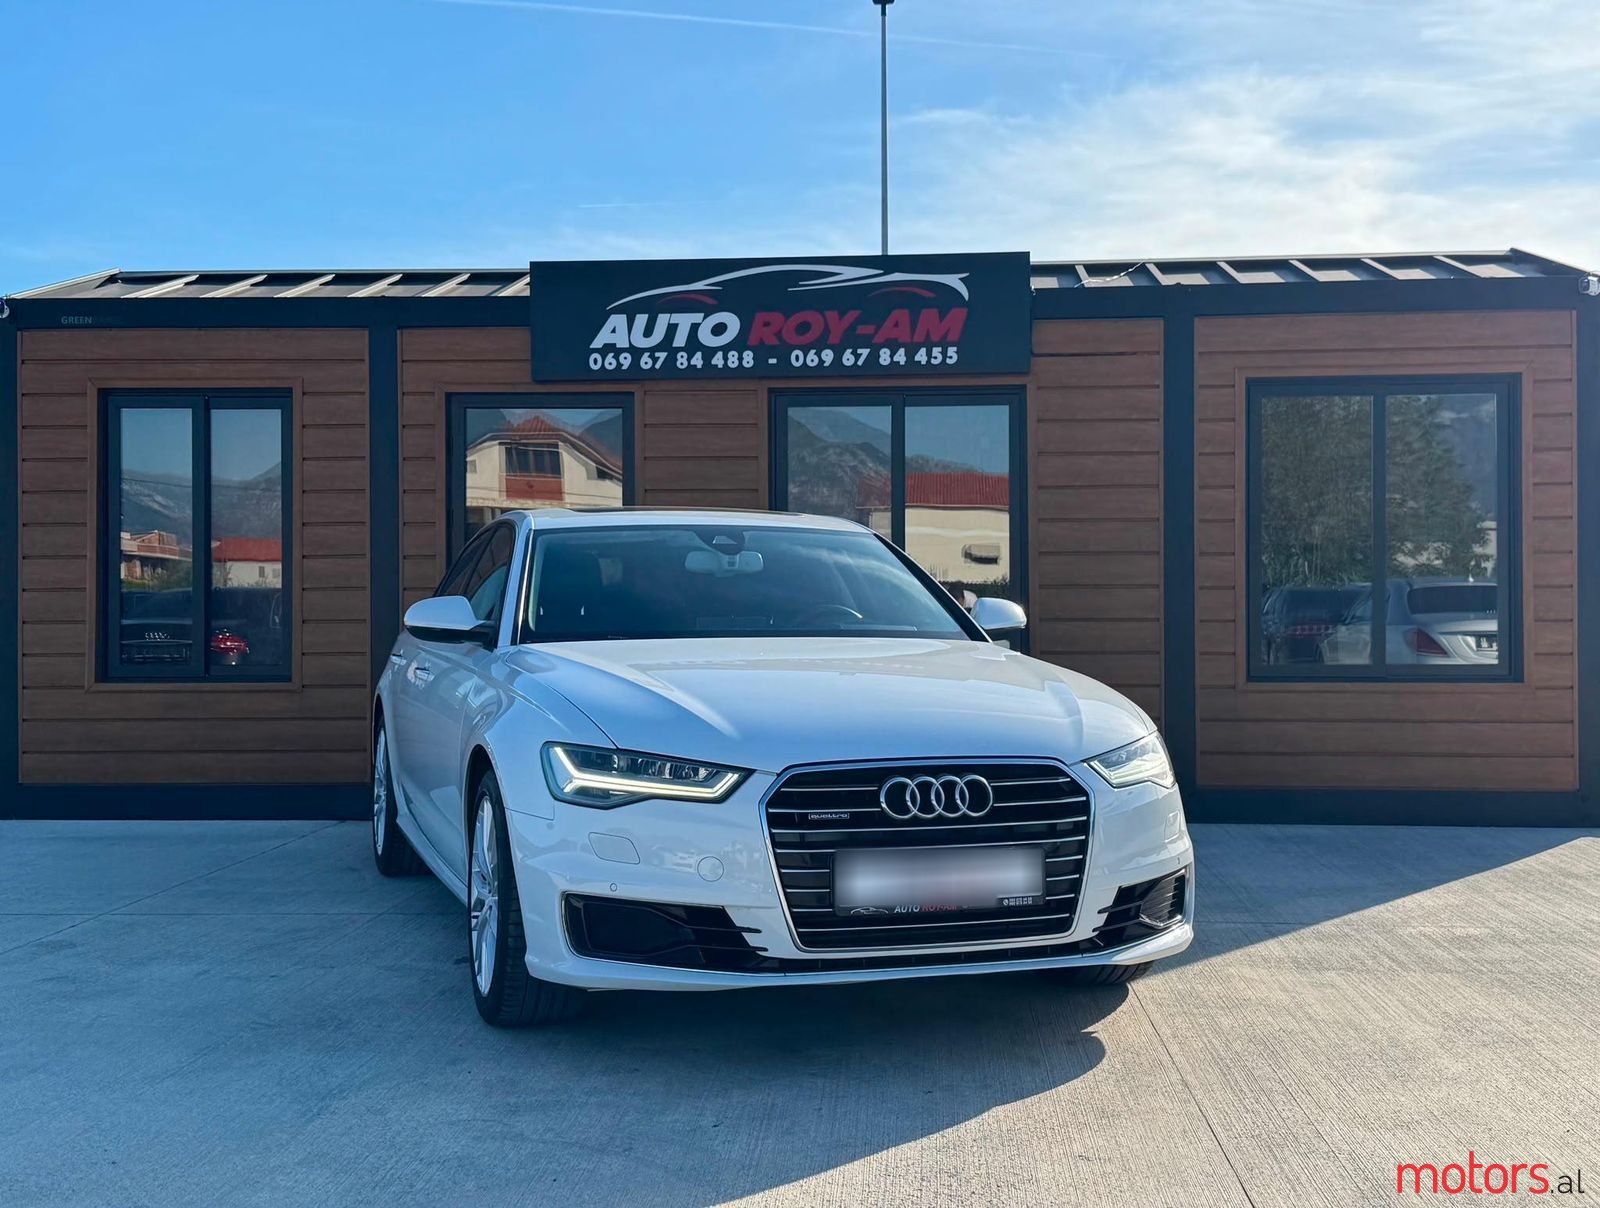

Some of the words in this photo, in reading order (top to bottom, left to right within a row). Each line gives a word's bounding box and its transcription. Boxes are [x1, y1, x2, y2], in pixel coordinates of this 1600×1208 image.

[61, 315, 93, 325] GREEN
[589, 311, 741, 349] AUTO
[747, 308, 969, 345] ROY-AM
[588, 352, 632, 371] 069
[640, 351, 668, 370] 67
[675, 350, 705, 369] 84
[711, 350, 755, 369] 488
[789, 349, 834, 368] 069
[842, 347, 871, 367] 67
[878, 347, 907, 366] 84
[914, 346, 959, 365] 455
[894, 904, 920, 914] AUTO
